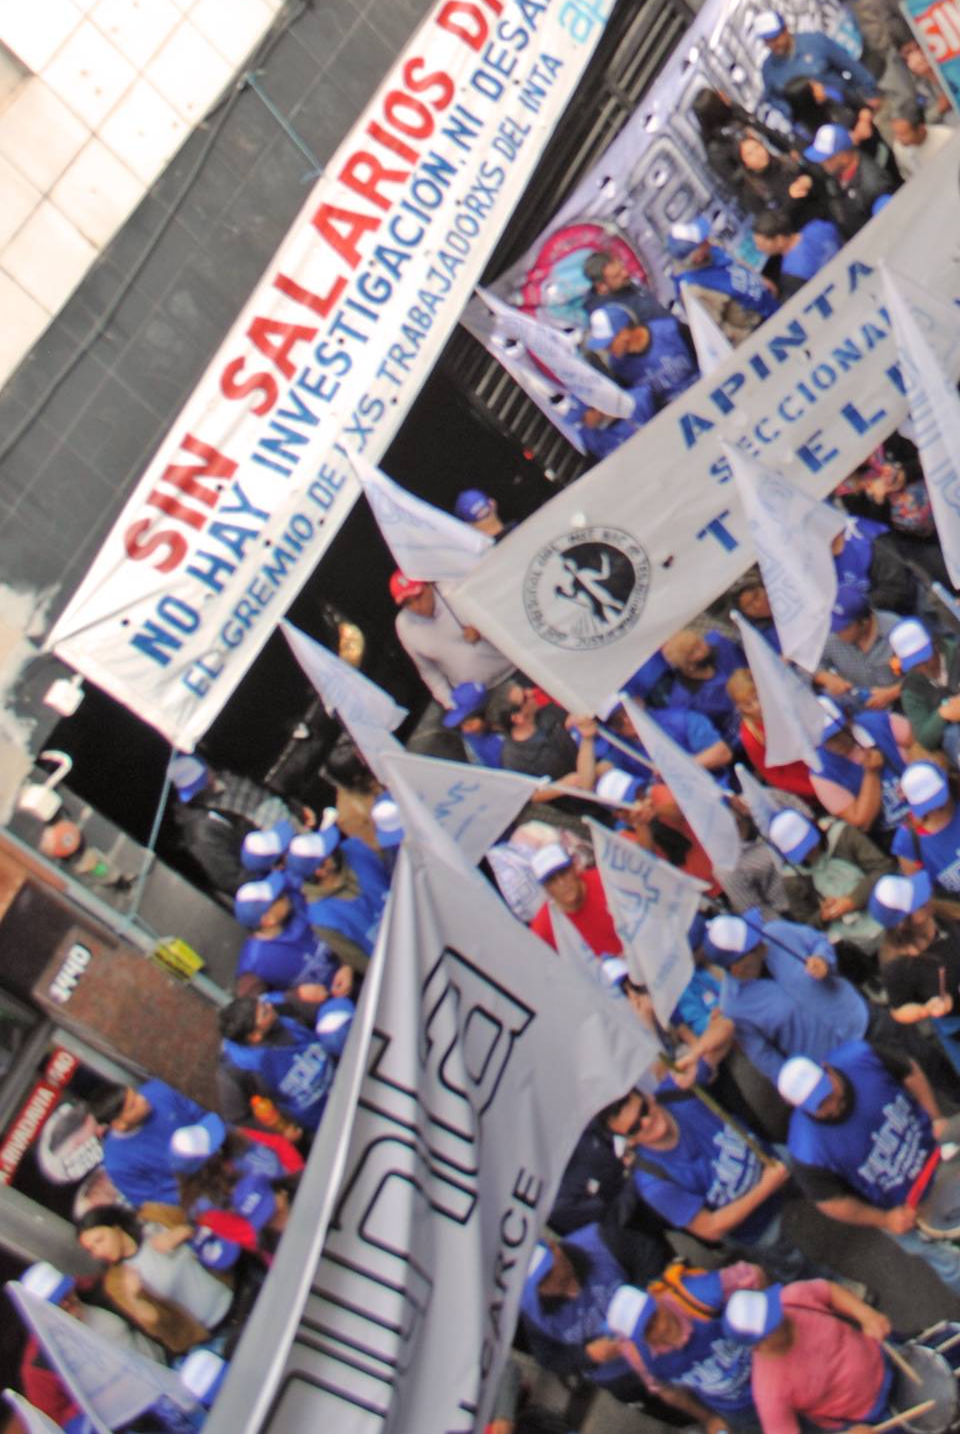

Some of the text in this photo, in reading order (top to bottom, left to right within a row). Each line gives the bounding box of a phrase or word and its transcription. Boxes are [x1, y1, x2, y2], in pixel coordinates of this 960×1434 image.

[124, 433, 239, 574] SIN
[219, 56, 456, 417] SALARIOS
[130, 595, 200, 667] NO
[186, 481, 271, 593] HAY
[441, 104, 484, 152] NI
[181, 654, 226, 699] EL
[220, 513, 315, 650] GREMIO
[307, 464, 347, 509] DE
[376, 161, 505, 386] TRABAJADORXS
[491, 116, 532, 162] DEL
[518, 53, 564, 113] INTA
[678, 260, 875, 450] APINTA
[50, 943, 91, 1004] 1440
